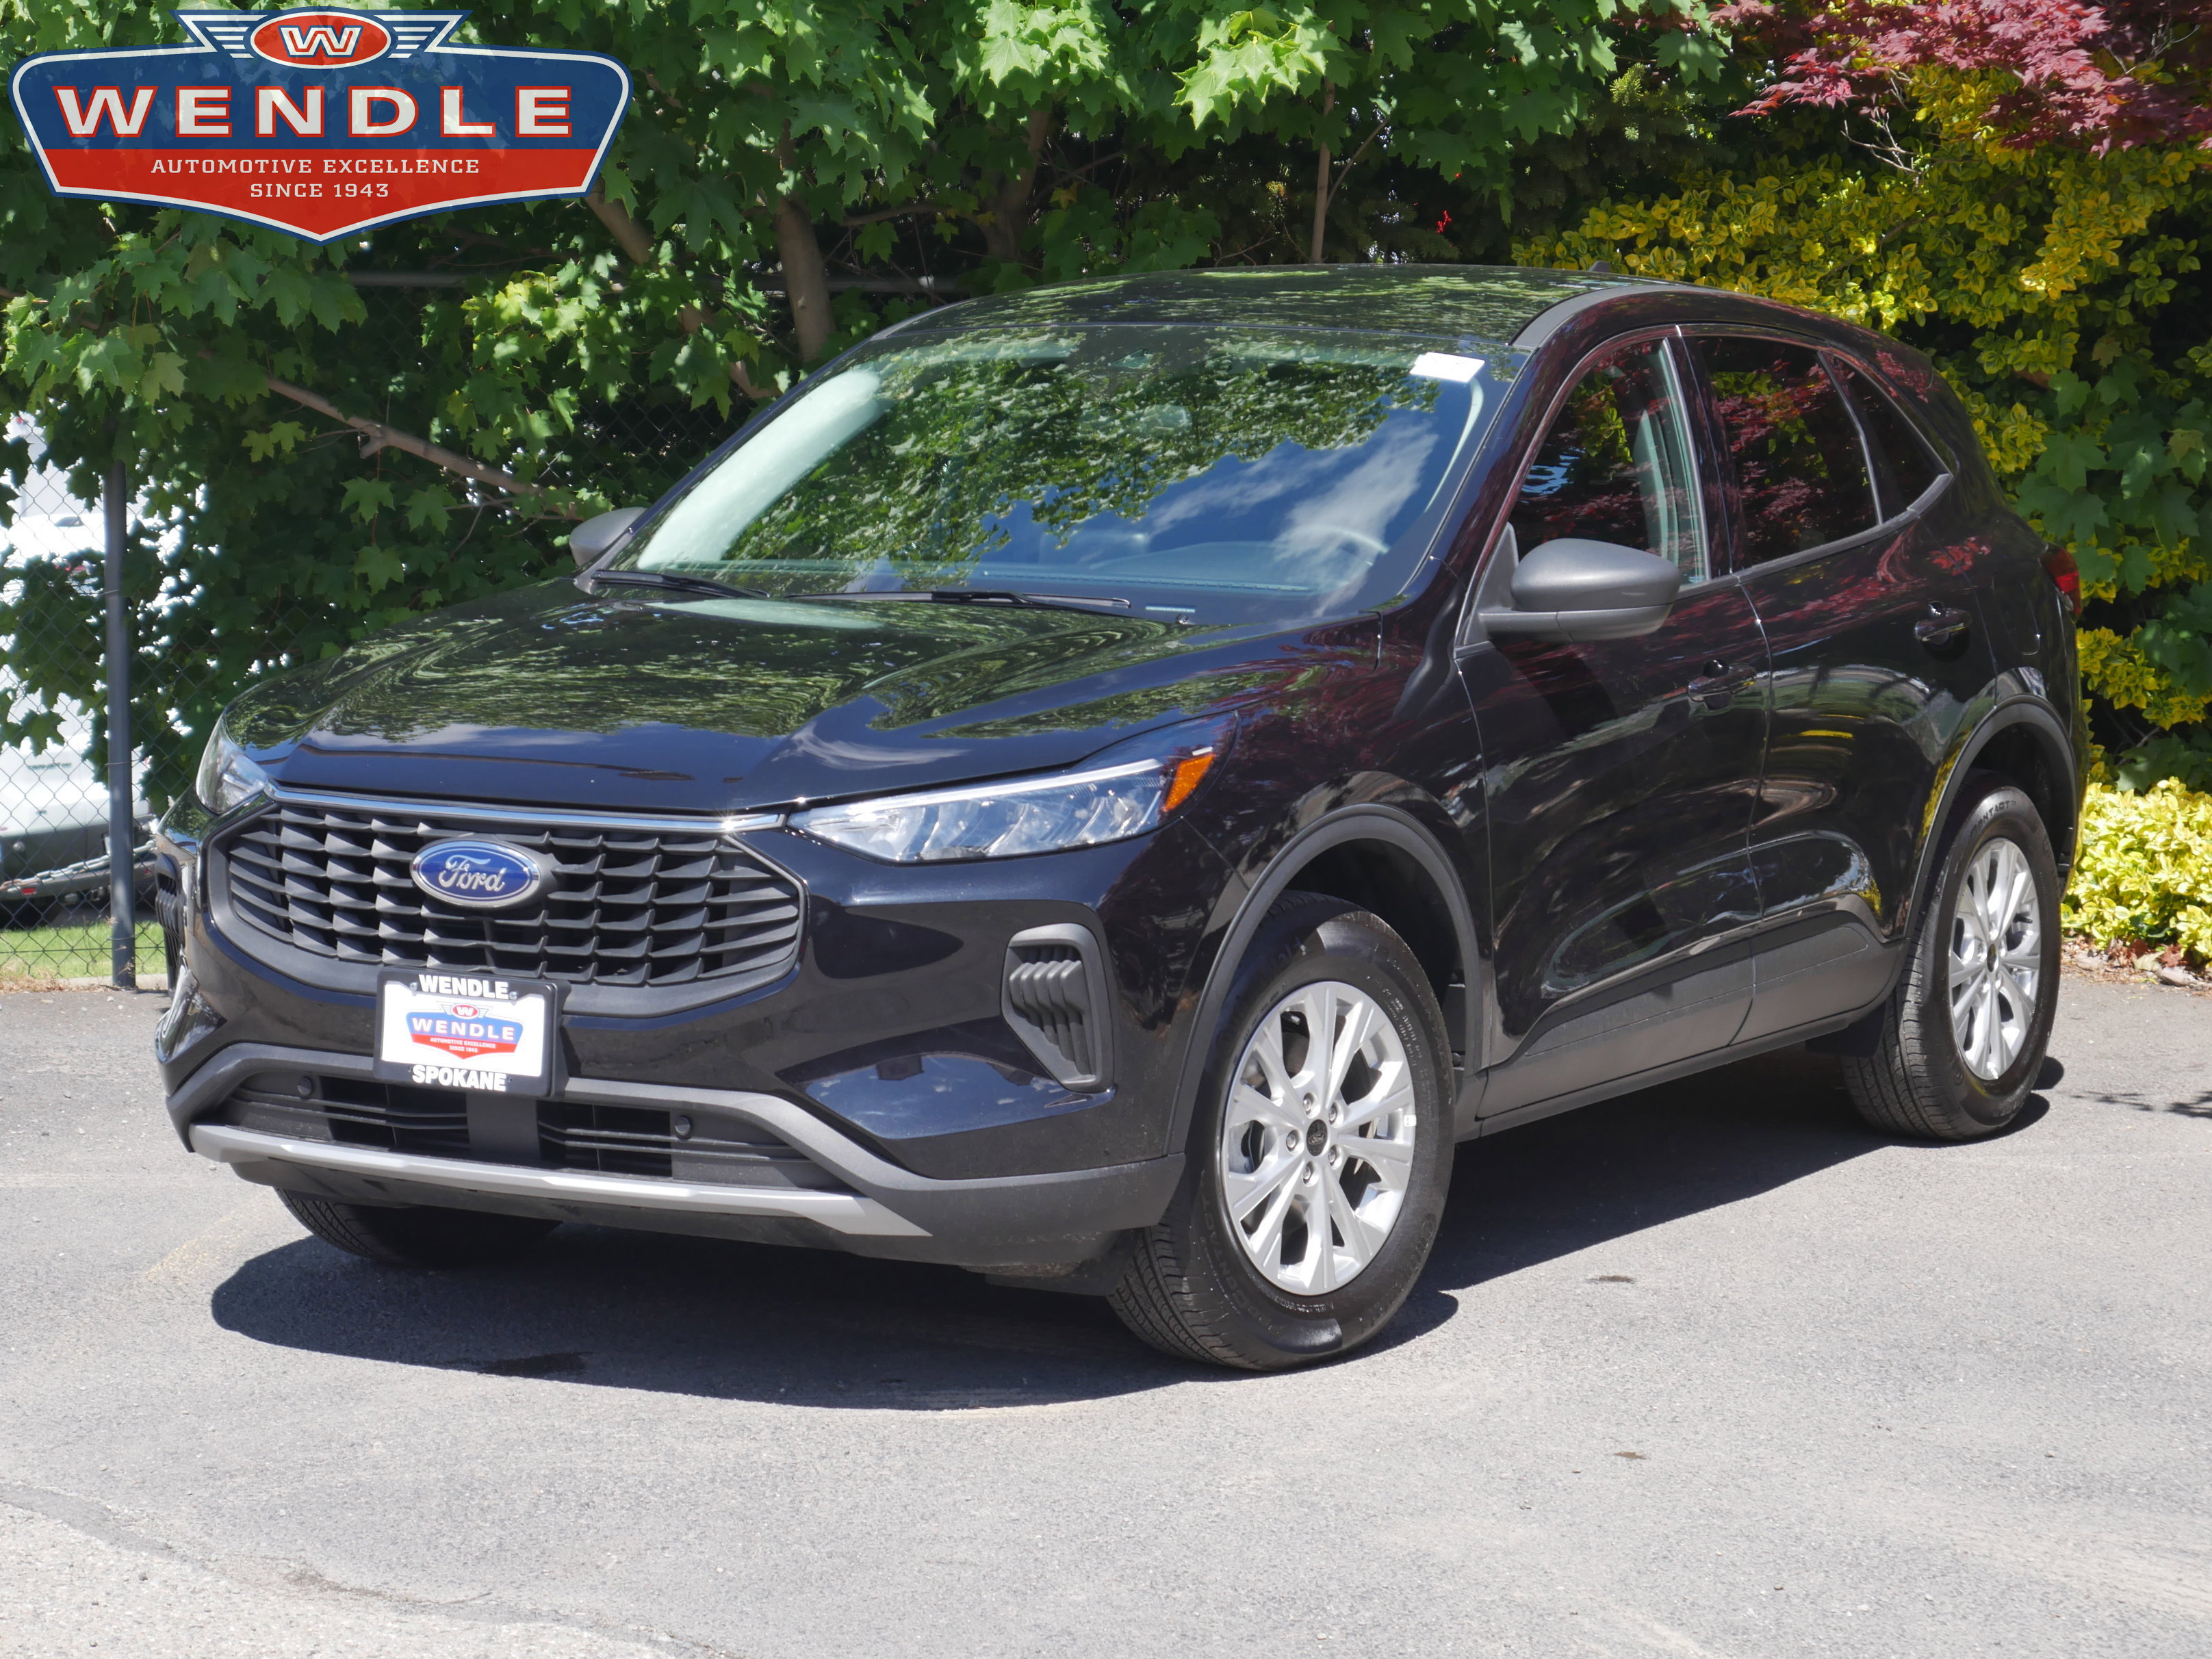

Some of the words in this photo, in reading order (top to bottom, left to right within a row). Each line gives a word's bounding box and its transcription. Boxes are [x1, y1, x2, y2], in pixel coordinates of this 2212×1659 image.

[438, 854, 507, 892] Ford
[419, 974, 509, 999] WENDLE
[456, 1006, 474, 1016] W
[412, 1018, 515, 1040] WENDLE
[430, 1037, 463, 1045] AUTOMOTIVE
[463, 1040, 496, 1049] EXCELLENCE
[412, 1064, 506, 1092] SPOKANE
